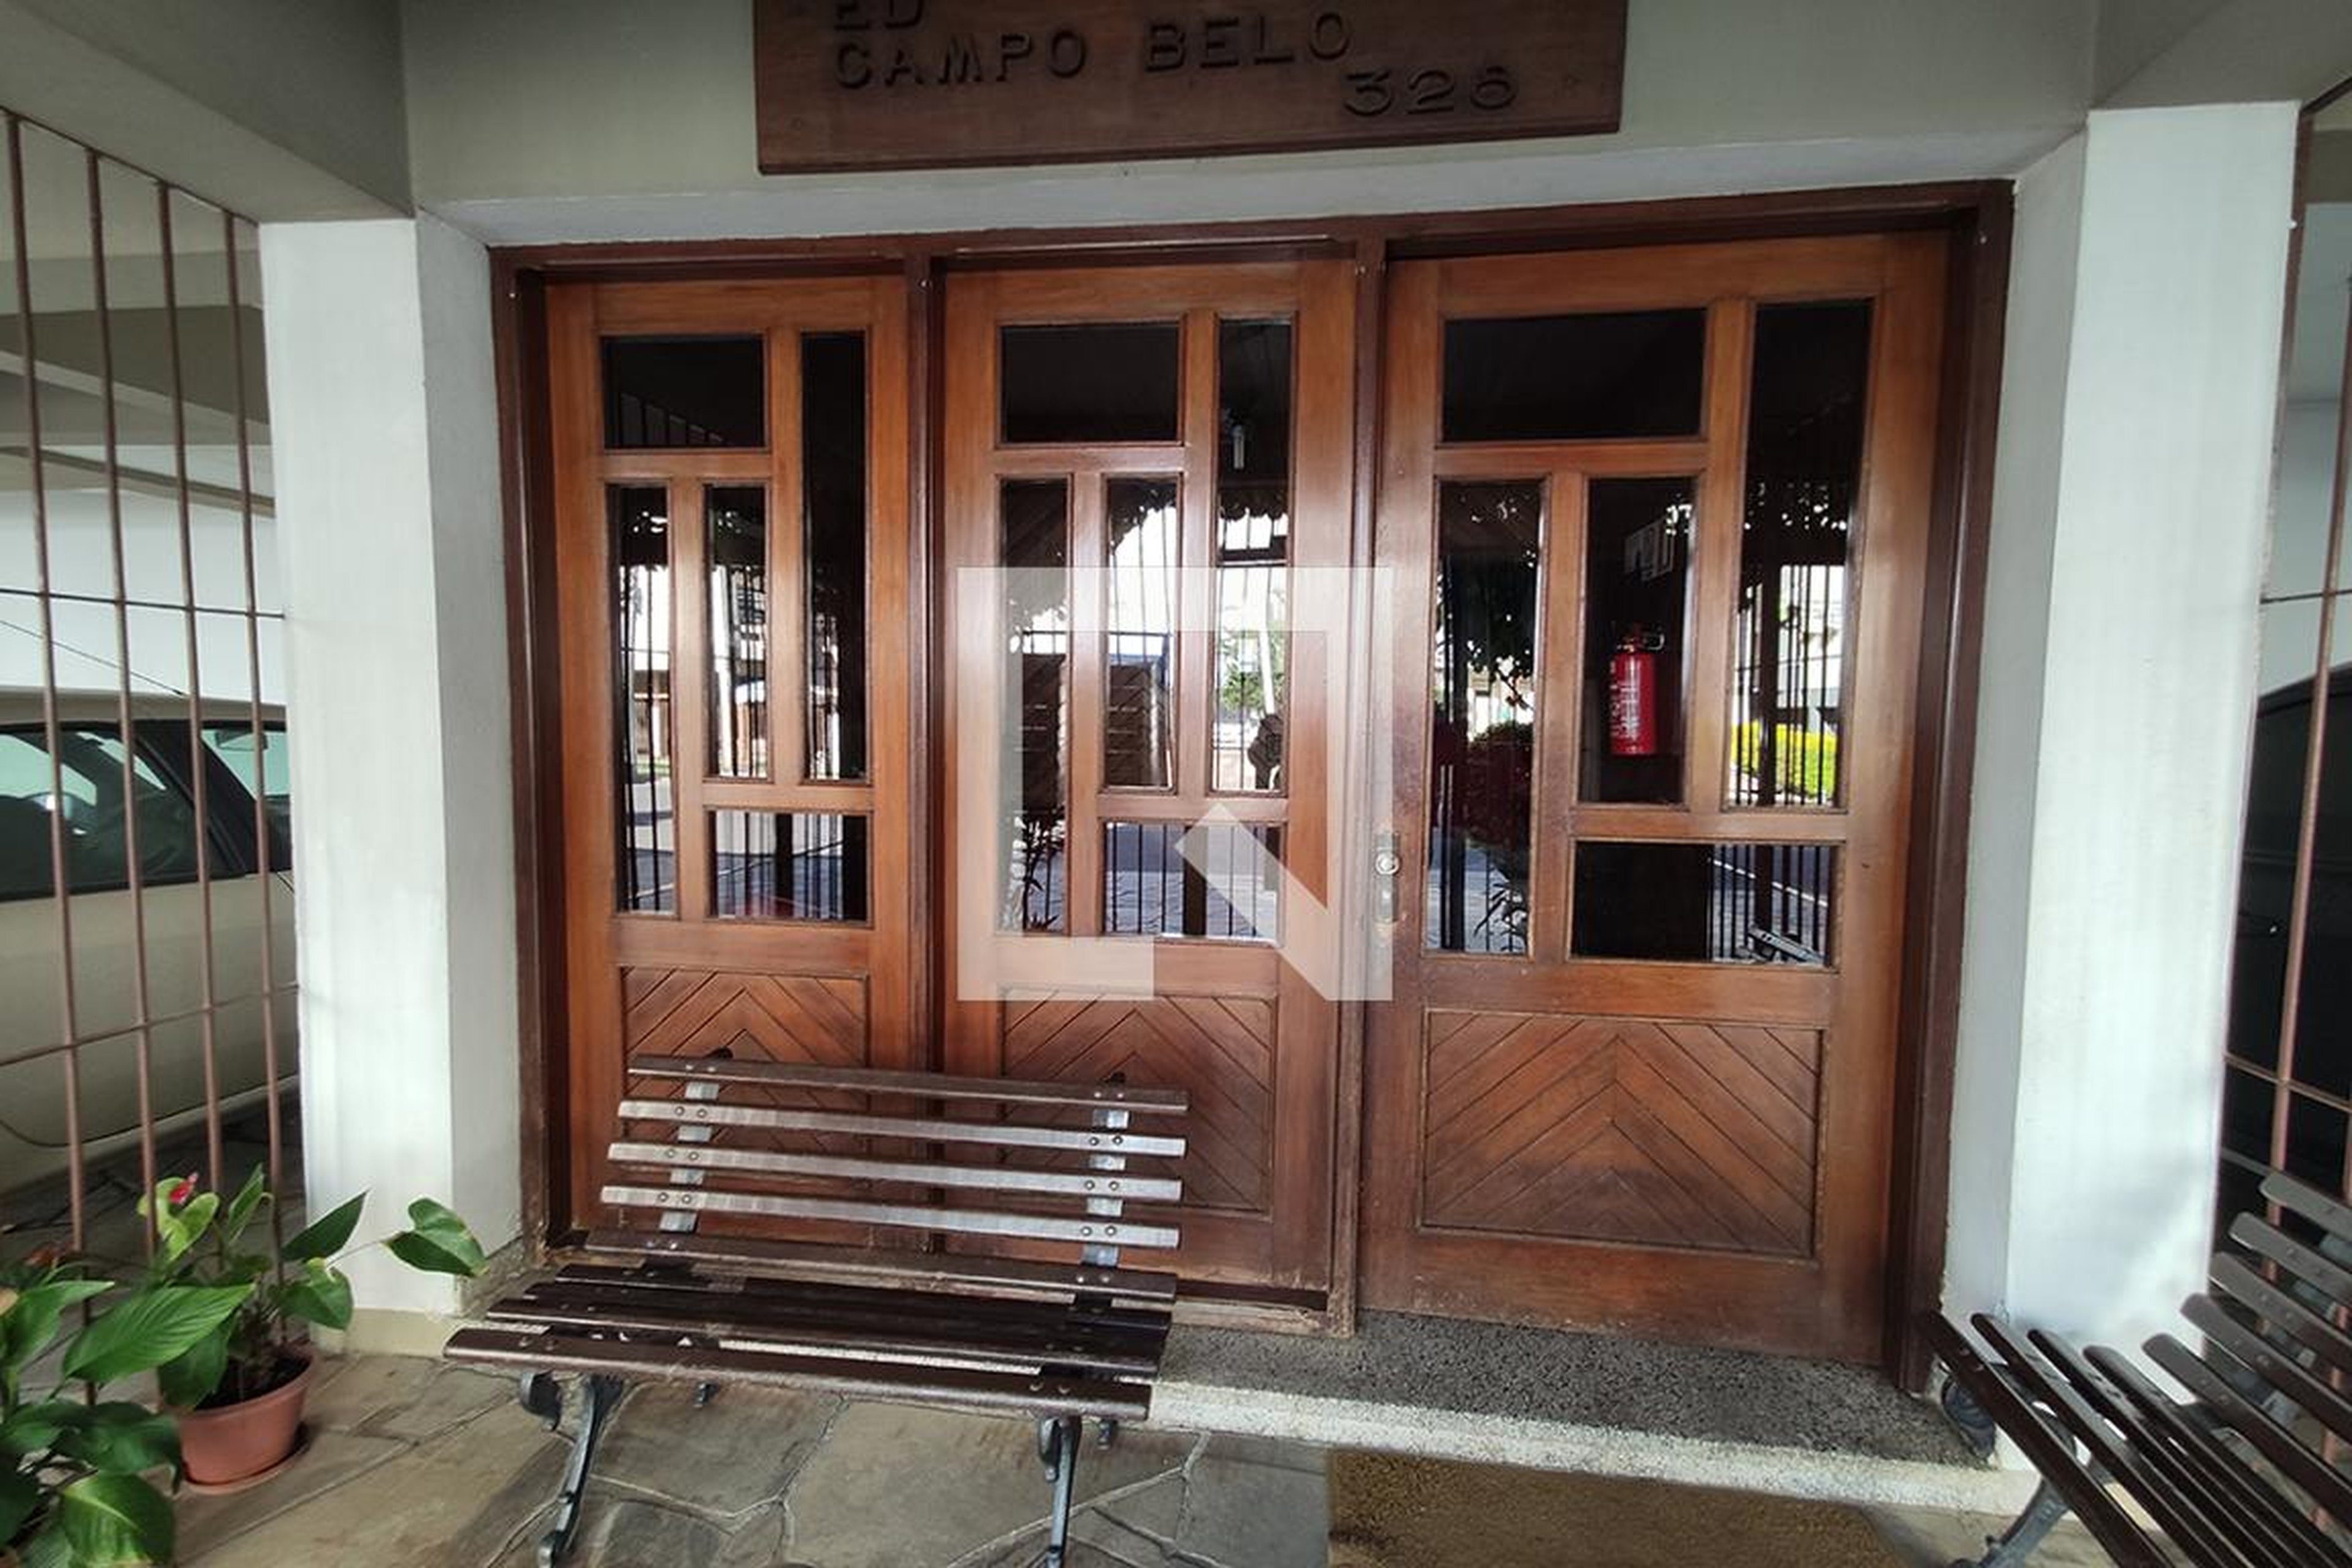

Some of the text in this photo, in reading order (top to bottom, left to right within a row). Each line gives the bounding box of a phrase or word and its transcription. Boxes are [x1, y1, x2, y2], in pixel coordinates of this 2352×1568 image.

[833, 0, 925, 31] ED
[834, 9, 1351, 90] CAMPO BELO
